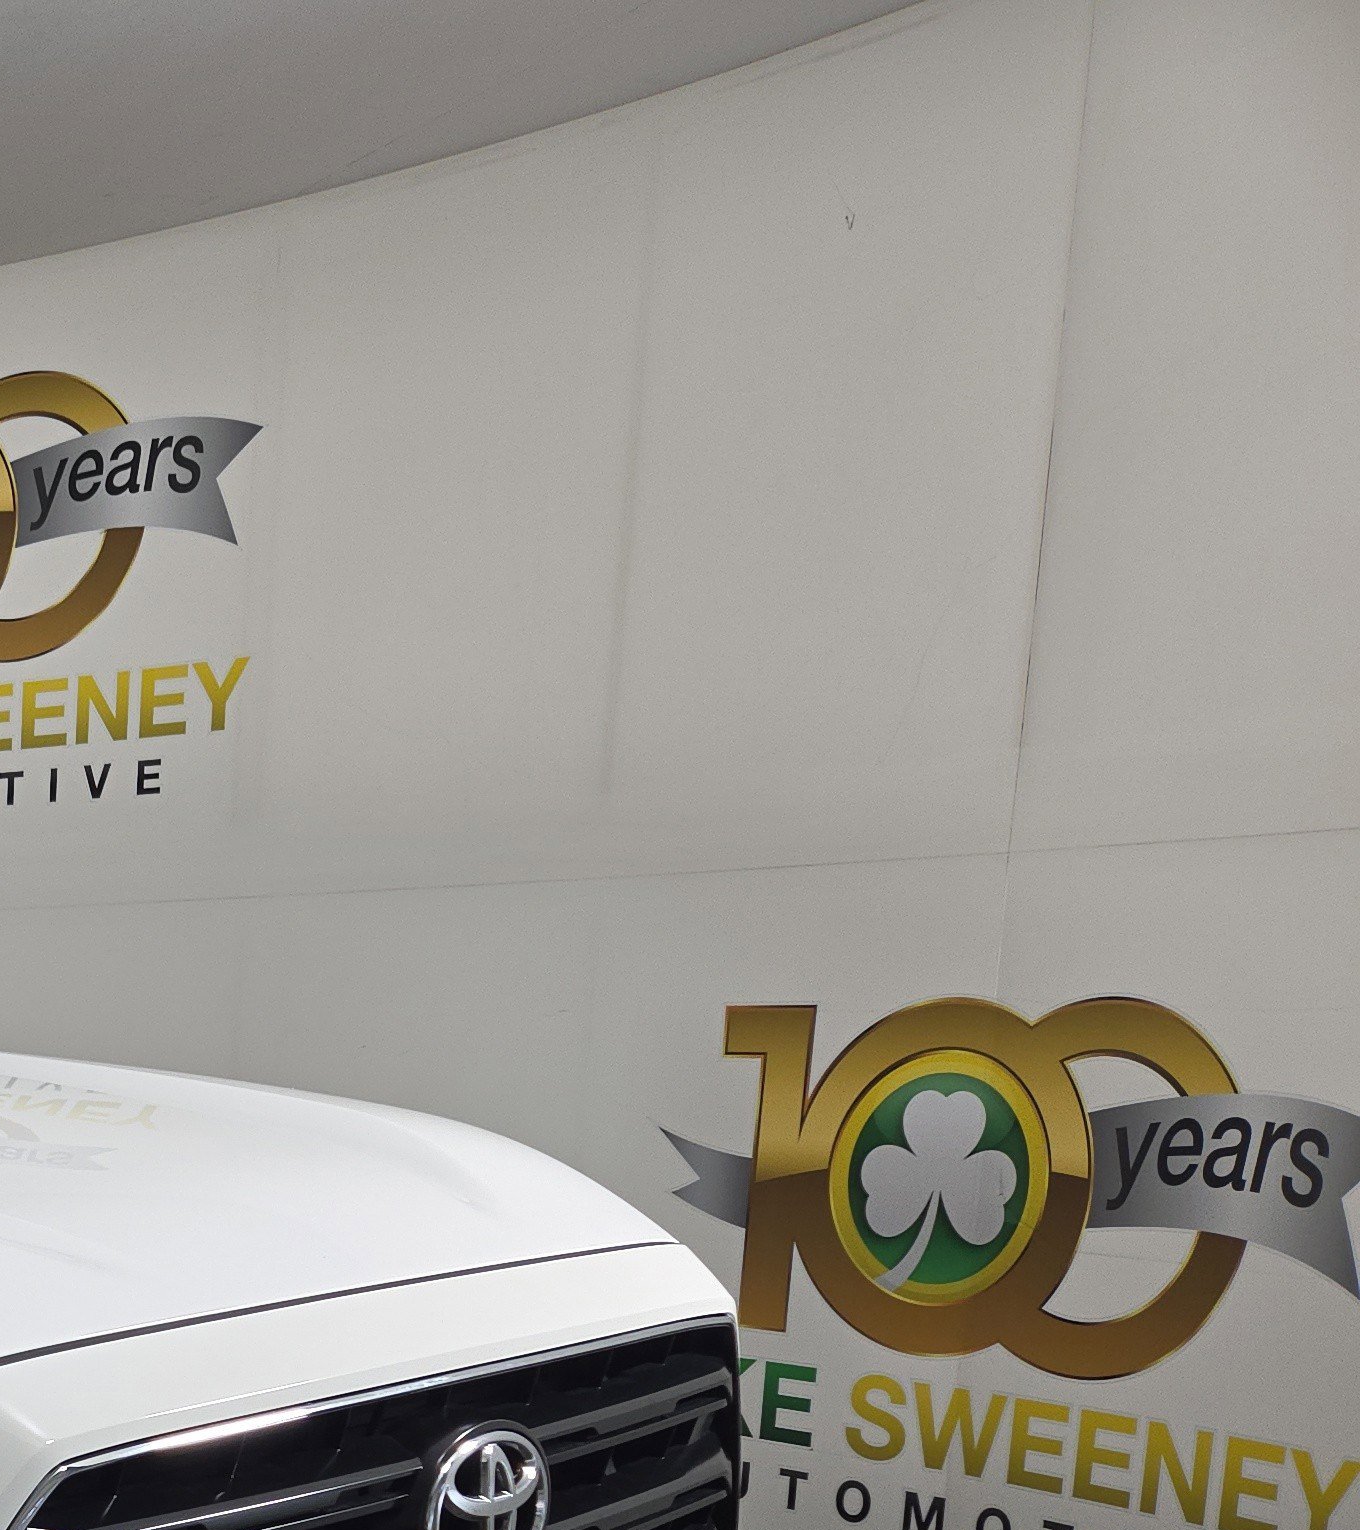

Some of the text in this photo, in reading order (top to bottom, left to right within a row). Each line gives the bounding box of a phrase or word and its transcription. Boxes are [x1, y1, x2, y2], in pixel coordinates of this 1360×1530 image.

[28, 432, 204, 531] years
[724, 996, 1248, 1380] 100
[1105, 1114, 1330, 1210] years
